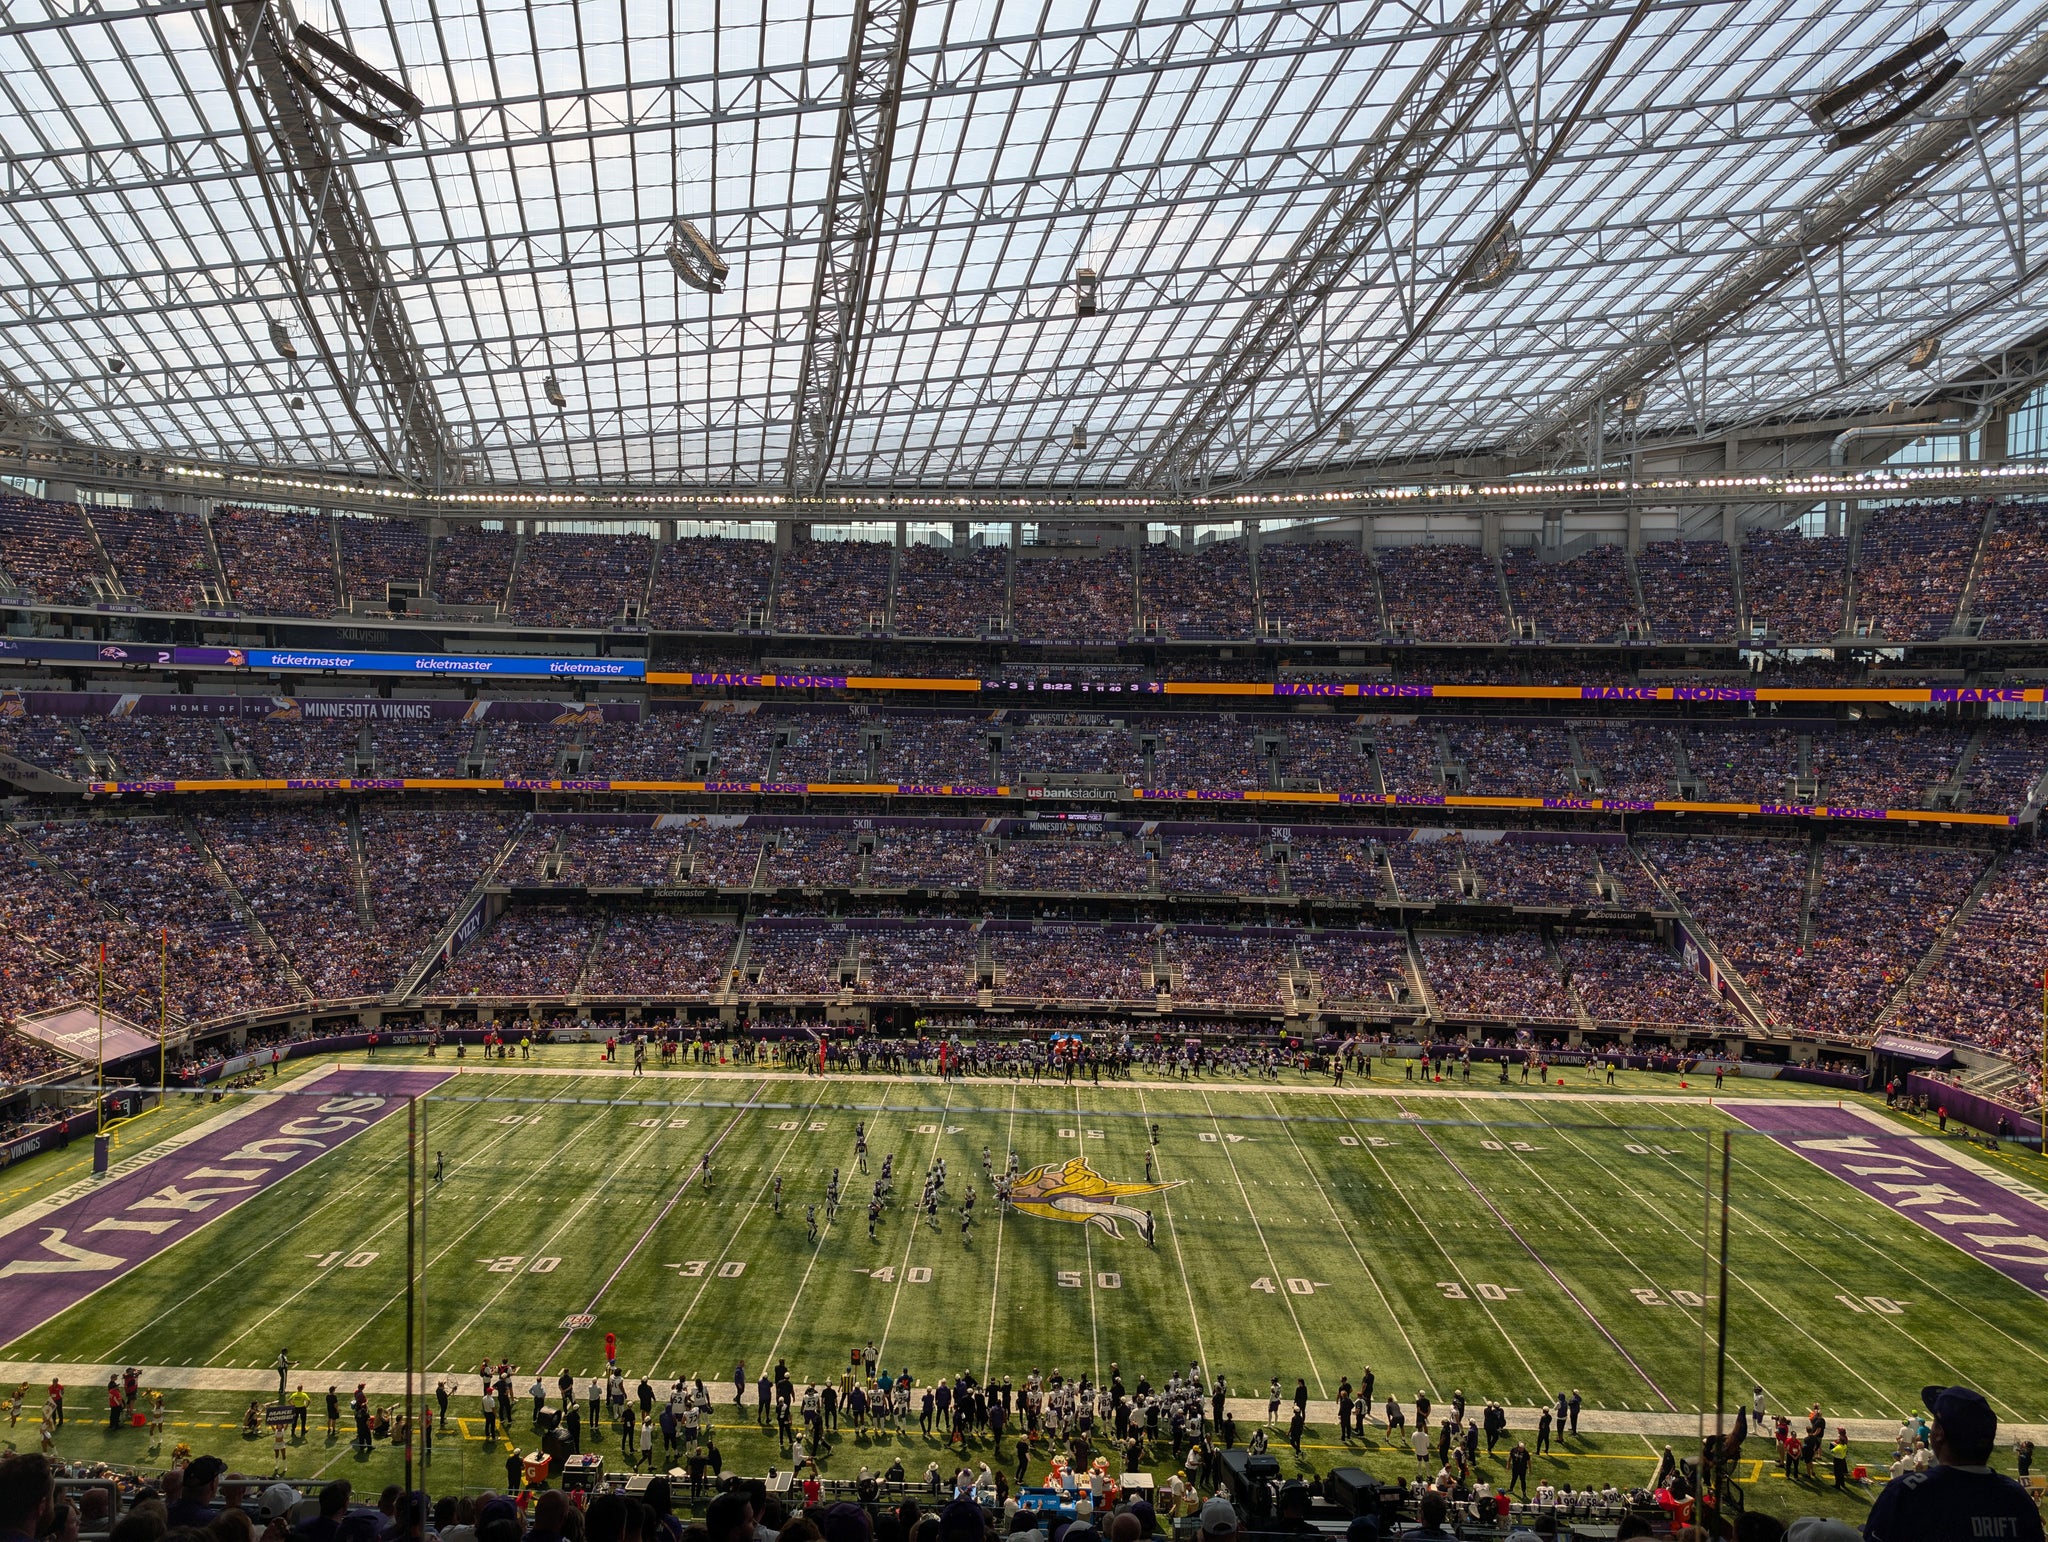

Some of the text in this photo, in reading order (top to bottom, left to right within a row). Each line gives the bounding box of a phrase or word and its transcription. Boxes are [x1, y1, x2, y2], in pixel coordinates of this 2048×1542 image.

[336, 628, 389, 643] SKOLVISION
[271, 654, 354, 667] ticketmaster
[415, 658, 493, 671] ticketmaster
[550, 661, 624, 674] ticketmaster
[692, 673, 848, 688] MAKE NOISE
[1009, 682, 1018, 690] 3
[1042, 683, 1072, 691] 8:22
[1130, 683, 1139, 691] 3
[1274, 683, 1434, 697] MAKE NOISE
[1581, 687, 1757, 700] MAKE NOISE
[1931, 688, 2024, 702] MAKE
[170, 704, 270, 713] HOME OF THE
[305, 703, 431, 719] MINNESOTA VIKINGS
[849, 705, 870, 716] SKOL
[1605, 720, 1630, 728] VIKINGS
[117, 781, 176, 792] NOISE
[287, 779, 405, 789] MAKE NOISE
[503, 780, 611, 790] MAKE NOISE
[704, 782, 808, 793] MAKE NOISE
[898, 785, 999, 795] MAKE NOISE
[1142, 789, 1245, 800] MAKE NOISE
[1339, 794, 1446, 805] MAKE NOISE
[1543, 799, 1655, 810] MAKE NOISE
[1760, 805, 1887, 818] MAKE NOISE
[853, 819, 873, 830] SKOL
[1029, 822, 1103, 832] MINNESOTA VIKINGS
[653, 889, 707, 898] ticketmaster
[1617, 912, 1637, 920] LIGHT
[457, 910, 482, 942] VIZZY
[392, 1035, 410, 1044] SKOL
[1897, 1044, 1940, 1055] HYUNDAI
[1559, 1055, 1587, 1065] VIKINGS
[10, 1137, 41, 1159] VIKINGS
[43, 1139, 189, 1206] PLAY FOOTBALL
[0, 1096, 387, 1279] VIKINGS
[1792, 1136, 2048, 1294] VIKIN
[316, 1251, 380, 1268] 10
[486, 1255, 562, 1274] 20
[678, 1260, 747, 1279] 30
[869, 1265, 933, 1284] 40
[1057, 1270, 1122, 1289] 50
[1250, 1276, 1315, 1295] 40
[1436, 1282, 1507, 1301] 30
[1629, 1288, 1706, 1307] 20
[1834, 1295, 1905, 1314] 10
[852, 1349, 860, 1360] 3
[269, 1409, 293, 1417] MAKE
[527, 1467, 536, 1478] G
[1414, 1487, 1427, 1496] 50
[1970, 1516, 2019, 1538] DRIFT
